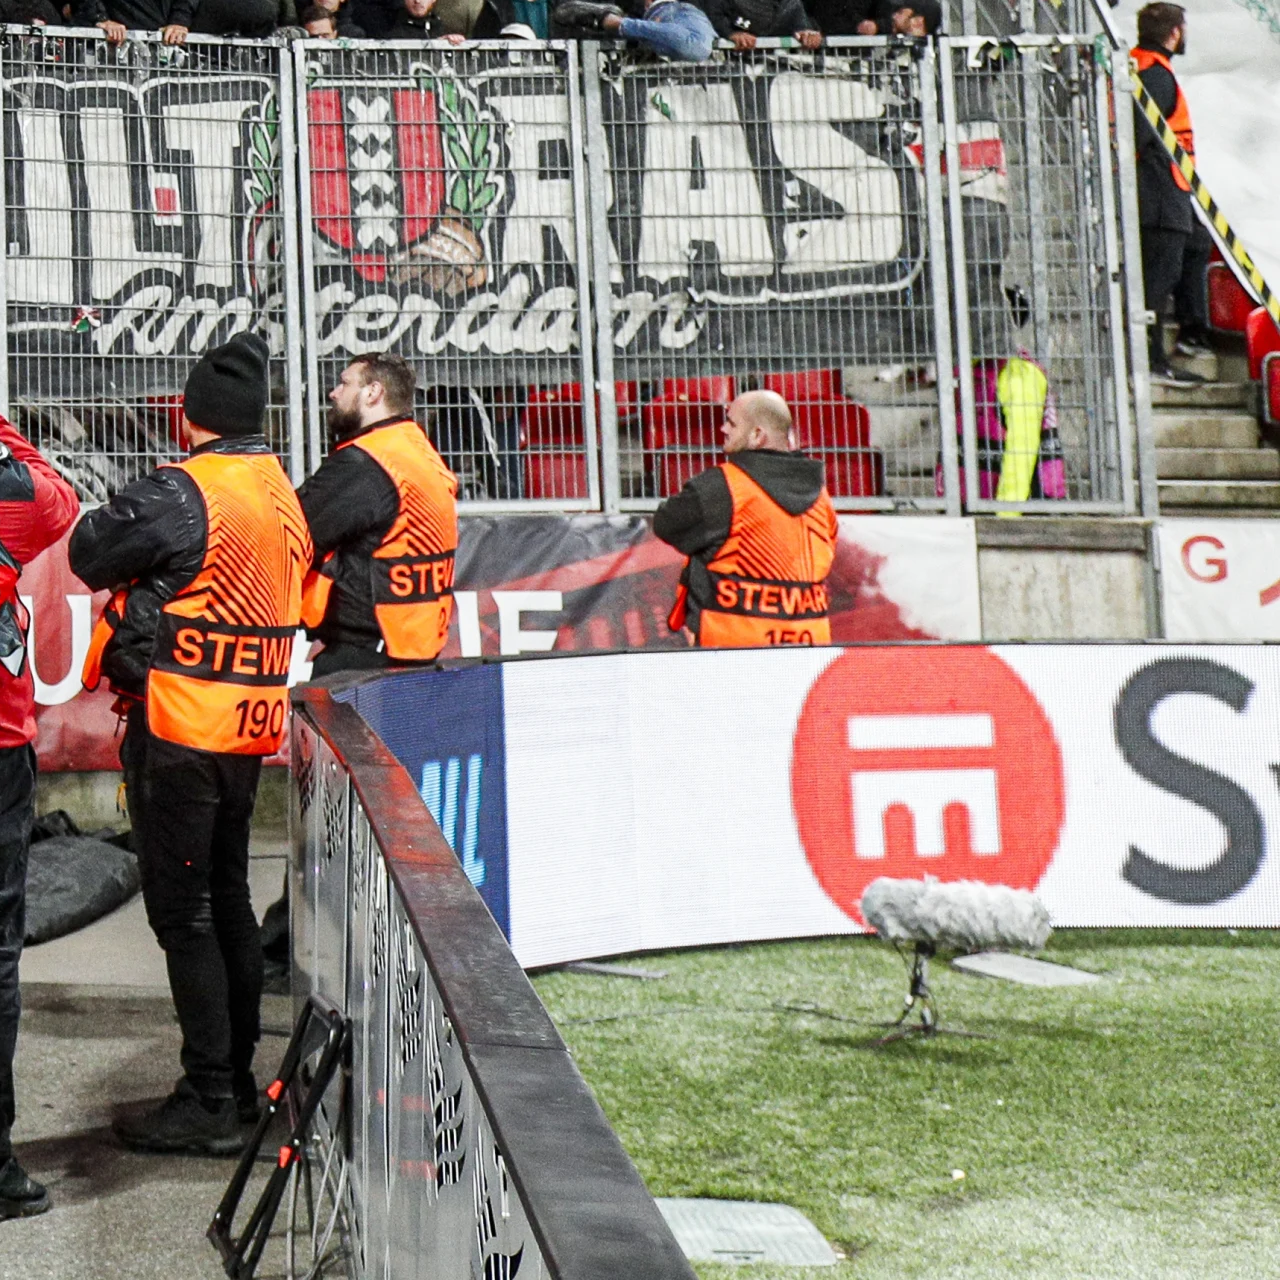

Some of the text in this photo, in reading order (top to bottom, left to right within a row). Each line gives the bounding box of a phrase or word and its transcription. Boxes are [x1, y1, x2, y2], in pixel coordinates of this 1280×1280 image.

[1180, 535, 1228, 583] G
[236, 698, 285, 739] 190
[1114, 655, 1280, 906] S
